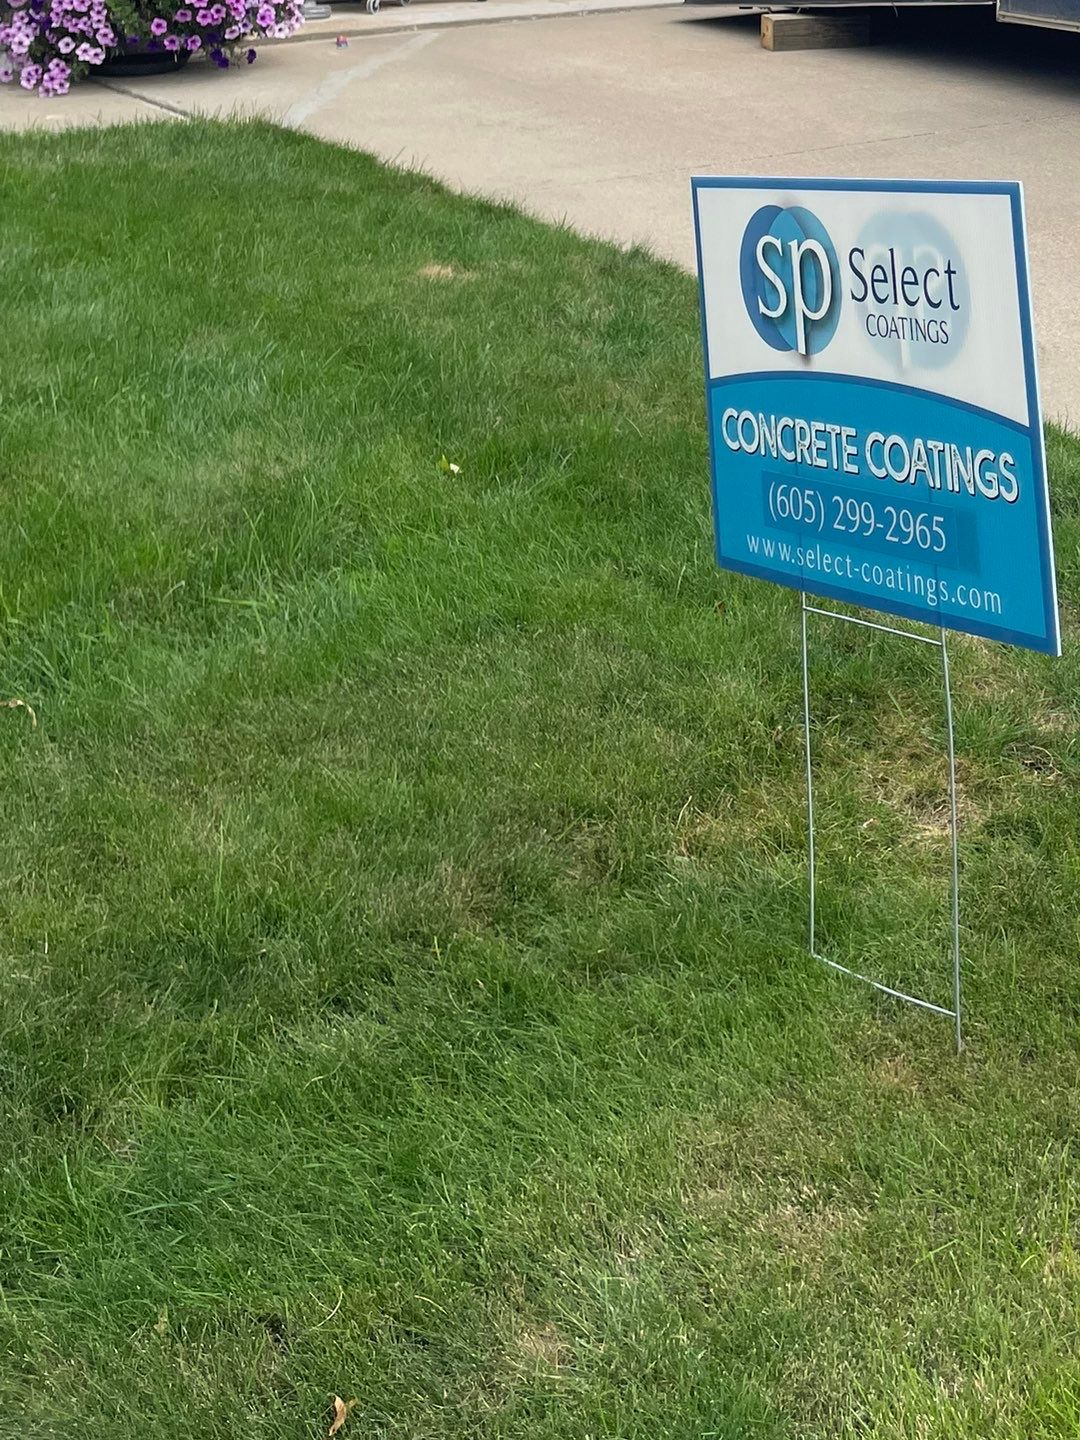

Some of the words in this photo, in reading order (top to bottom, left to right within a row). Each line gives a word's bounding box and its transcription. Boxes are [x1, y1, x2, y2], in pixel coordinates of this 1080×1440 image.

[848, 247, 960, 311] Select
[865, 314, 949, 345] COATINGS
[721, 407, 859, 474] CONCRETE
[865, 431, 1020, 504] COATINGS
[768, 480, 825, 533] (605)
[832, 495, 946, 552] 299-2965
[746, 531, 1002, 614] www.select-coatings.com
